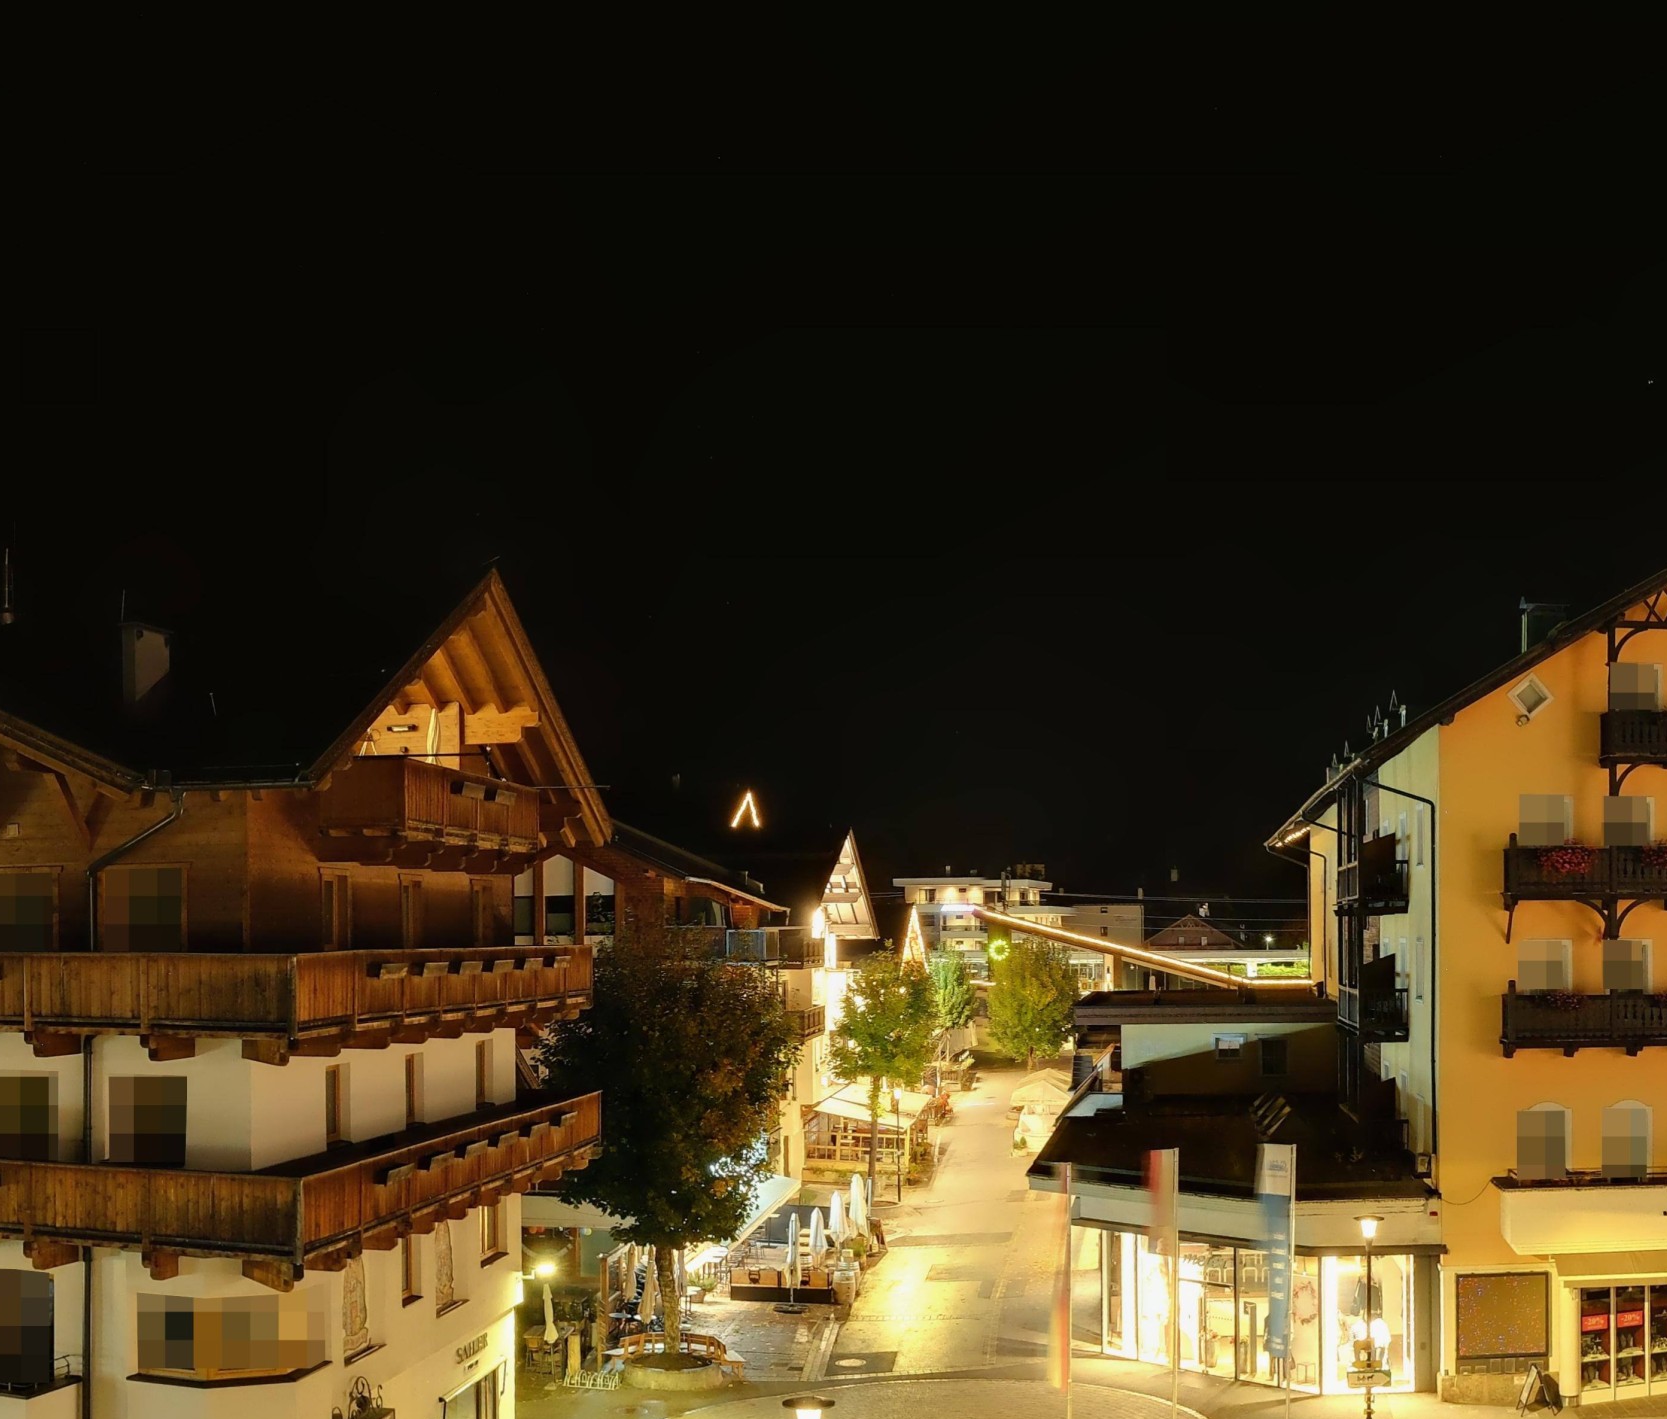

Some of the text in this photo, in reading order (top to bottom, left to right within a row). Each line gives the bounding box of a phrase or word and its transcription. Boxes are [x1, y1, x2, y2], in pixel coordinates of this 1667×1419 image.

[1584, 1316, 1605, 1326] -20%
[1620, 1313, 1641, 1323] -20%
[455, 1331, 489, 1365] SAILER
